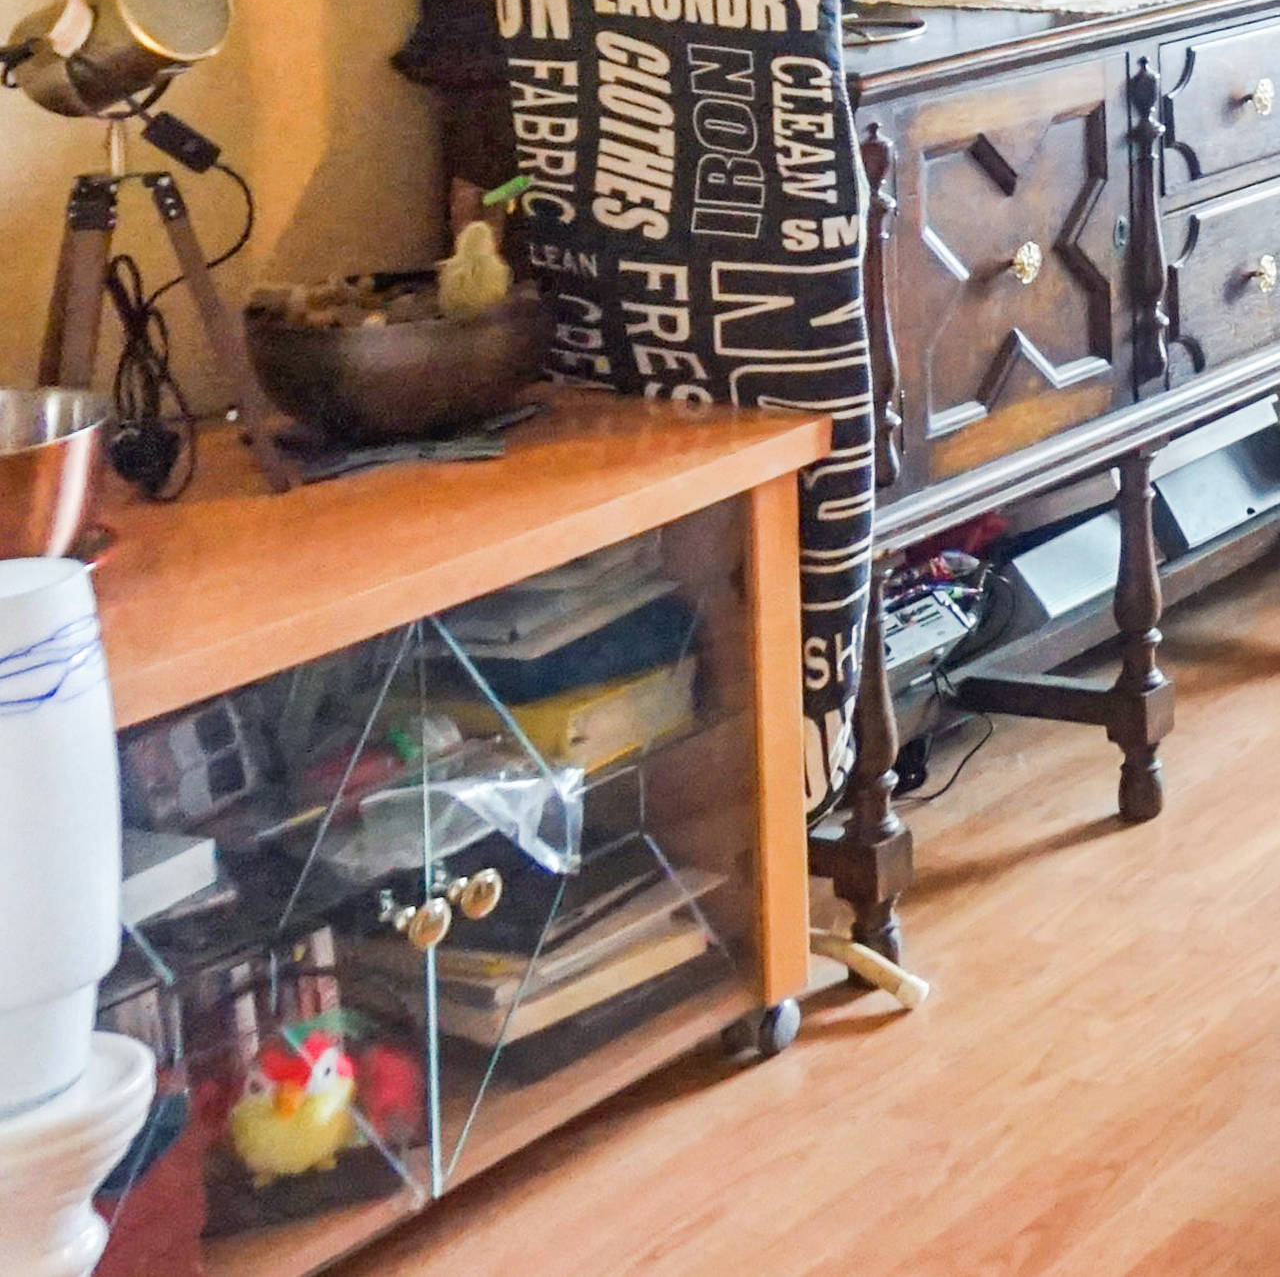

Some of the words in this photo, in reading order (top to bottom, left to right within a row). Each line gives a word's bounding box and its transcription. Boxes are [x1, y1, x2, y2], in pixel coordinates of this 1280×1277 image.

[508, 58, 579, 224] FABRIC
[591, 30, 677, 240] CLOTHES
[686, 42, 766, 239] IRON
[770, 56, 839, 205] CLEAN
